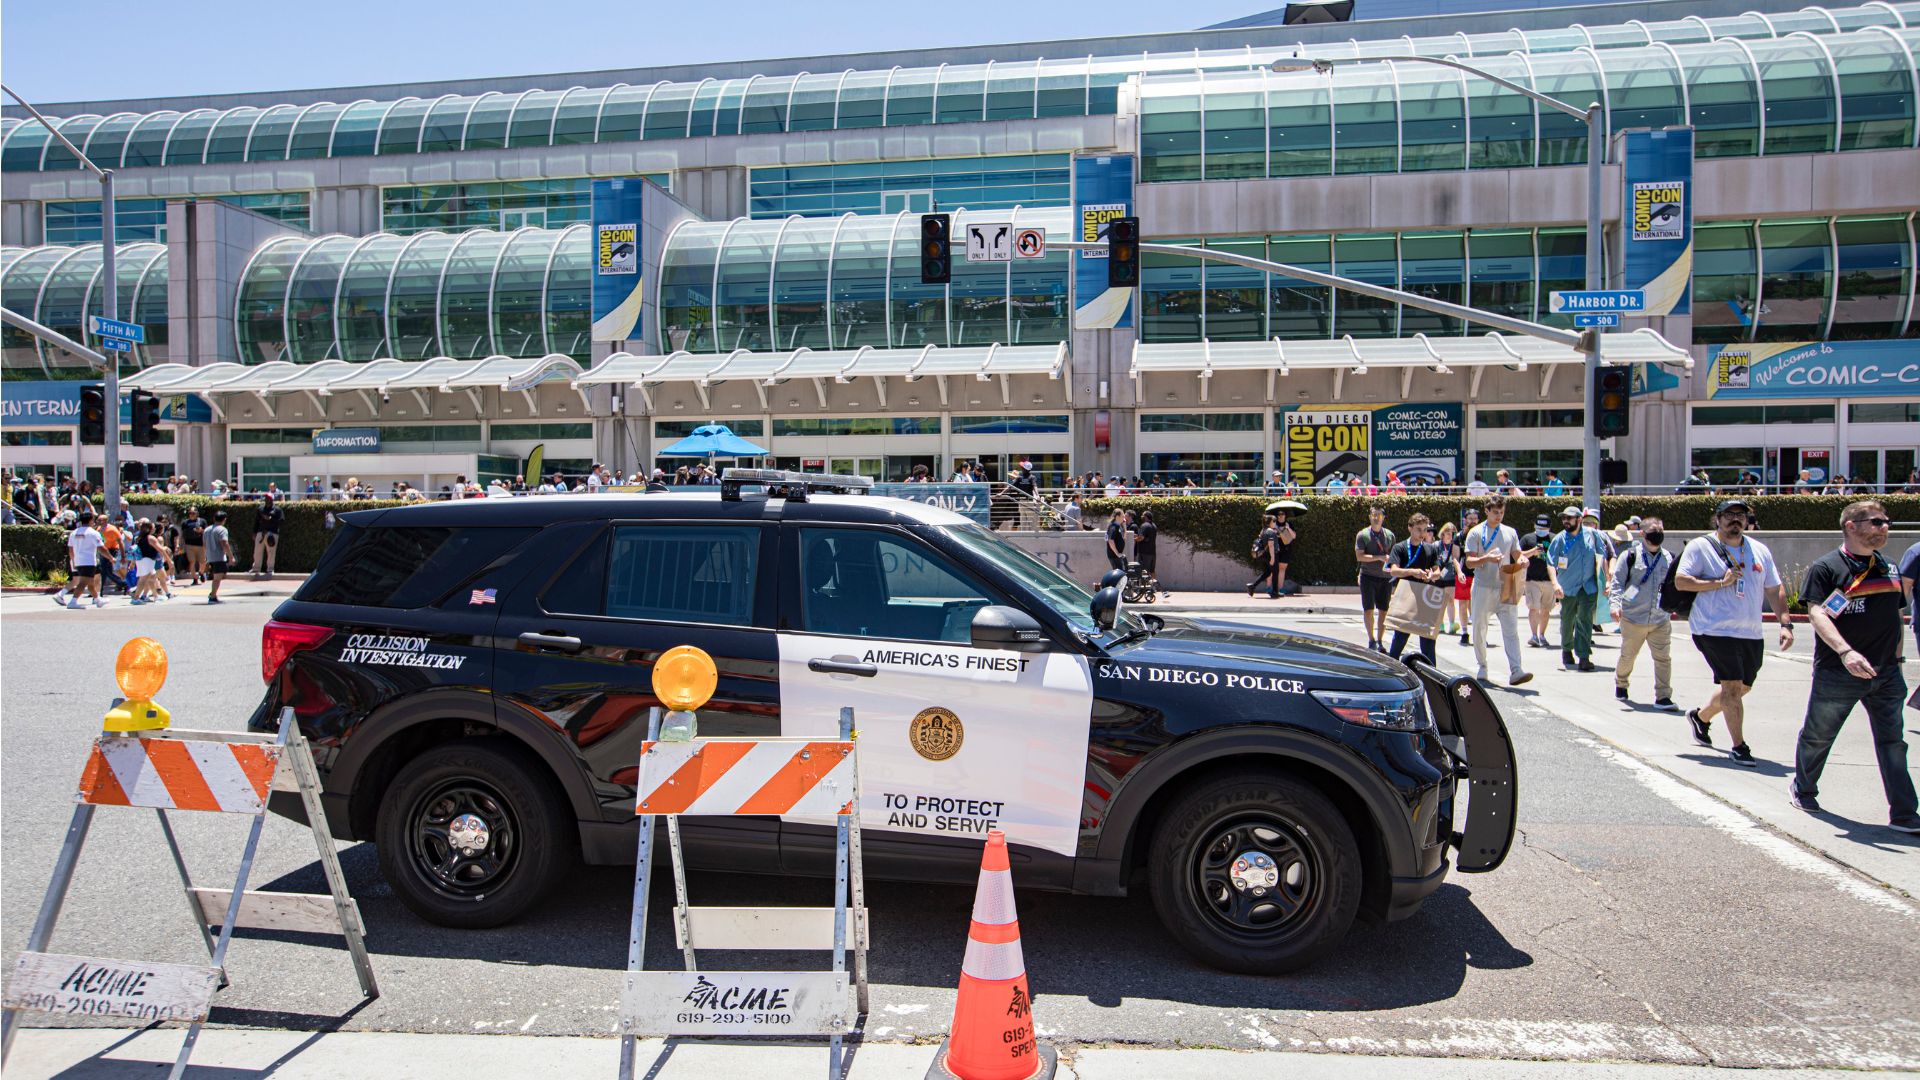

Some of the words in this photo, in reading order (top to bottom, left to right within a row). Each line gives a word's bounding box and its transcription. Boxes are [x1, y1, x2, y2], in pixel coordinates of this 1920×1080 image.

[1651, 188, 1681, 203] CON
[1635, 190, 1651, 231] COMIC
[611, 230, 634, 242] CON
[1085, 211, 1098, 242] OMIC
[600, 230, 612, 267] COMIC
[1568, 296, 1615, 308] HARBOR
[1620, 295, 1640, 307] DR.
[102, 322, 123, 335] FIFTH
[1597, 317, 1612, 325] 500
[1719, 356, 1729, 383] COMIC
[1729, 356, 1748, 366] CON
[1756, 347, 1818, 386] Welcome
[1821, 343, 1834, 354] to
[1287, 415, 1313, 424] SAN
[1326, 414, 1369, 423] DIEGO
[1376, 421, 1459, 431] INTERNATIONAL
[1387, 411, 1448, 420] COMIC-CON
[315, 436, 377, 448] INFORMATION
[1317, 425, 1368, 451] CON
[1390, 432, 1410, 440] SAN
[1414, 431, 1446, 440] DIEGO
[1289, 426, 1315, 494] OMIC
[1375, 449, 1458, 457] WWW.COMIC-CON.ORG
[347, 634, 430, 652] COLLISION
[338, 648, 466, 669] INVESTIGATION
[862, 649, 959, 668] AMERICA'S
[966, 655, 1030, 673] FINEST
[1099, 664, 1142, 681] SAN
[1148, 667, 1219, 686] DIEGO
[1226, 673, 1306, 694] POLICE
[883, 793, 908, 809] TO
[915, 796, 1004, 817] PROTECT
[887, 812, 928, 828] AND
[935, 815, 998, 834] SERVE
[60, 962, 155, 997] ACME
[699, 986, 790, 1011] ACME
